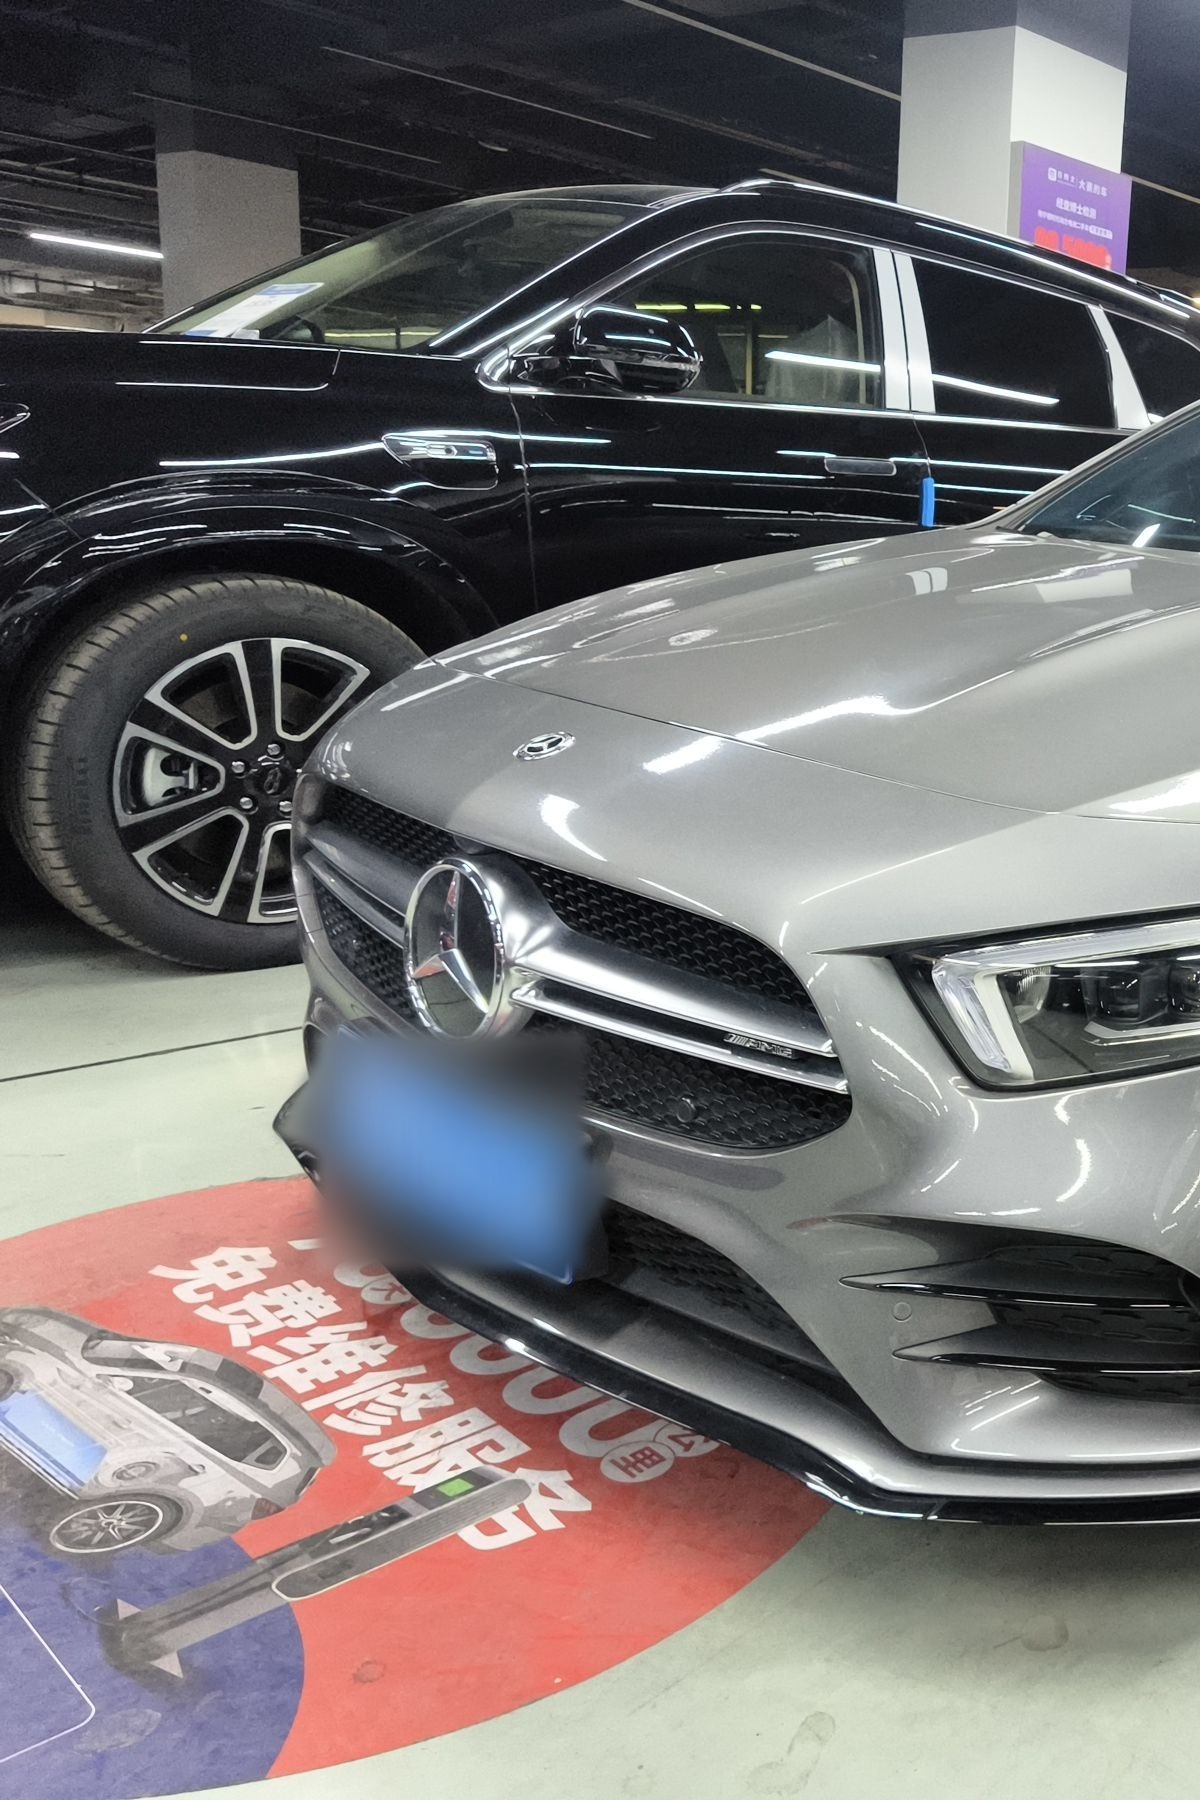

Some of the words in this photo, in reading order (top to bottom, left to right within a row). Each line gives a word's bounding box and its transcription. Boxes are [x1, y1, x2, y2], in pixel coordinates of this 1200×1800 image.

[148, 1246, 592, 1551] 免费维修服务
